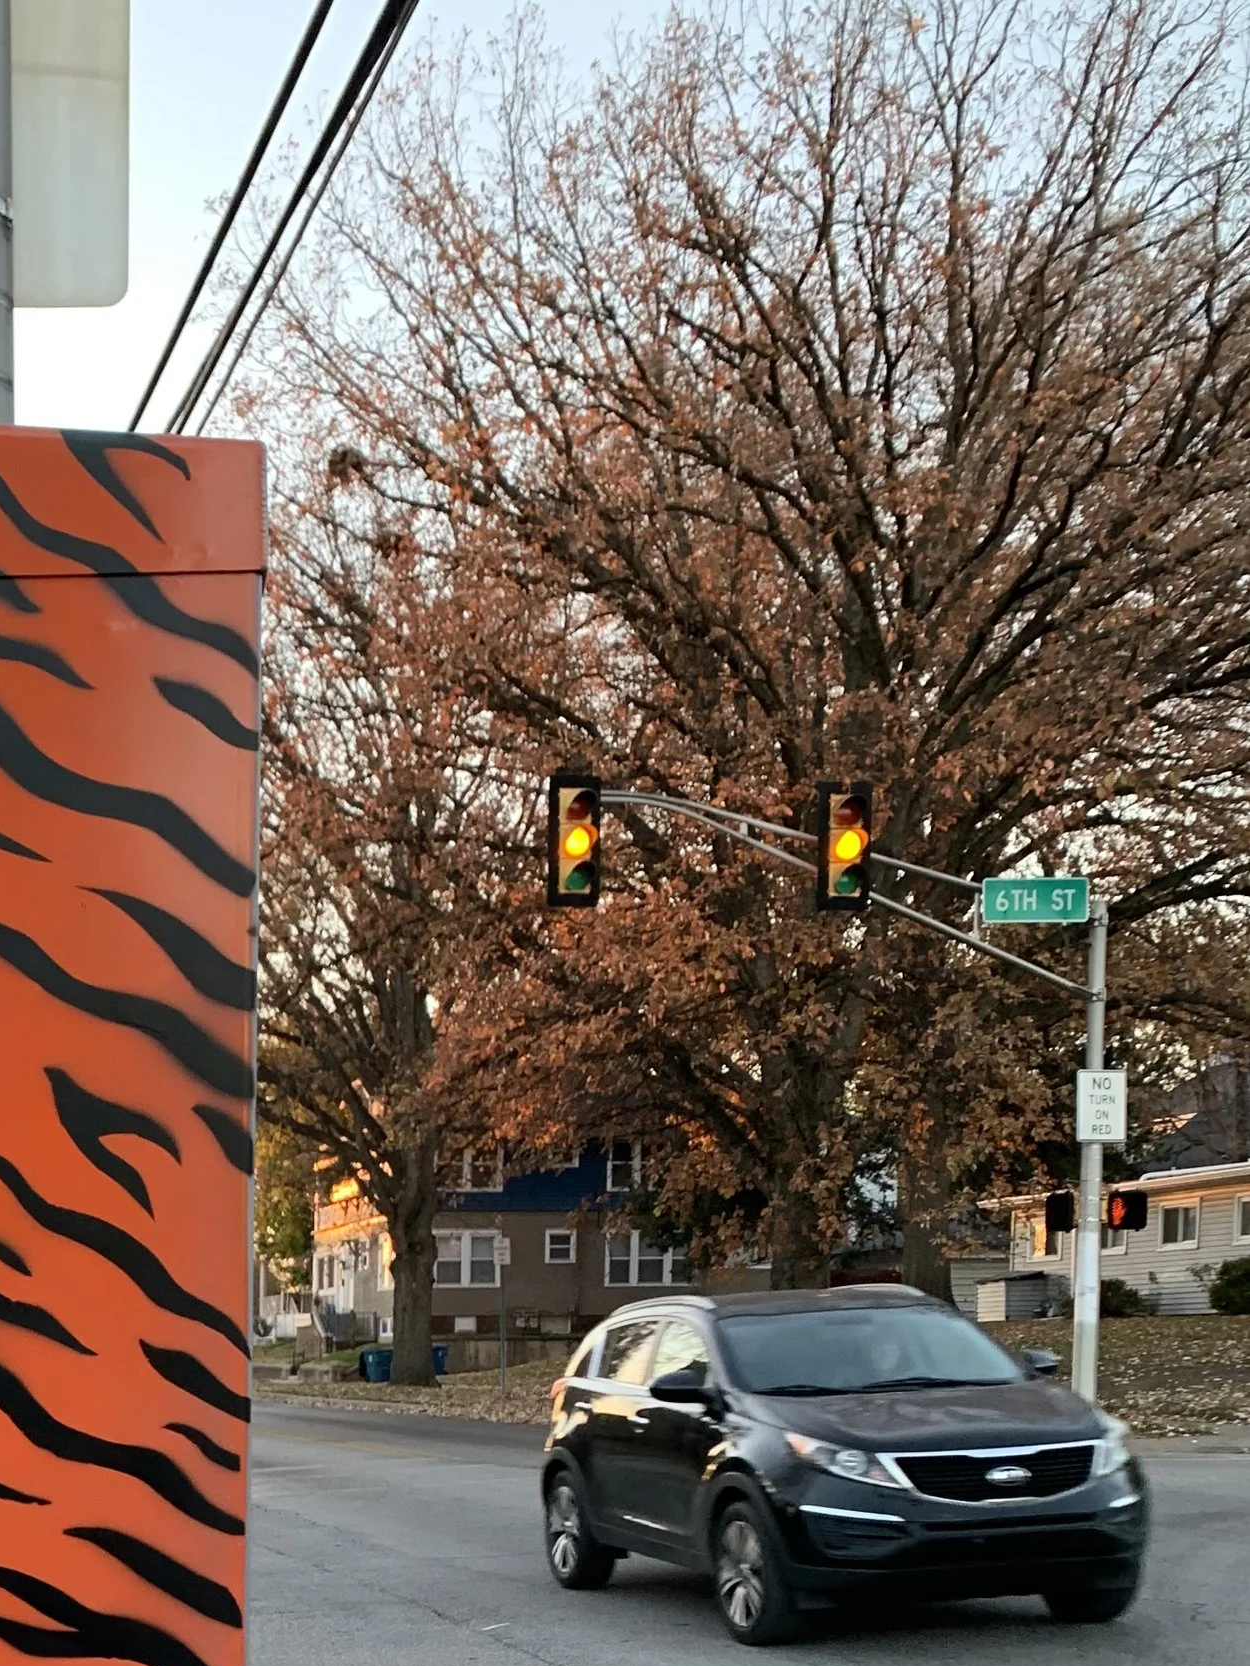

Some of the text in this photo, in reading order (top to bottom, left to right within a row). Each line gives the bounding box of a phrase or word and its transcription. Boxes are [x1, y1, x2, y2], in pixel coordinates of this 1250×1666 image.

[995, 888, 1076, 912] 6TH ST
[1092, 1077, 1112, 1090] NO
[1089, 1094, 1116, 1105] TURN
[1095, 1109, 1109, 1120] ON
[1091, 1124, 1112, 1135] RED
